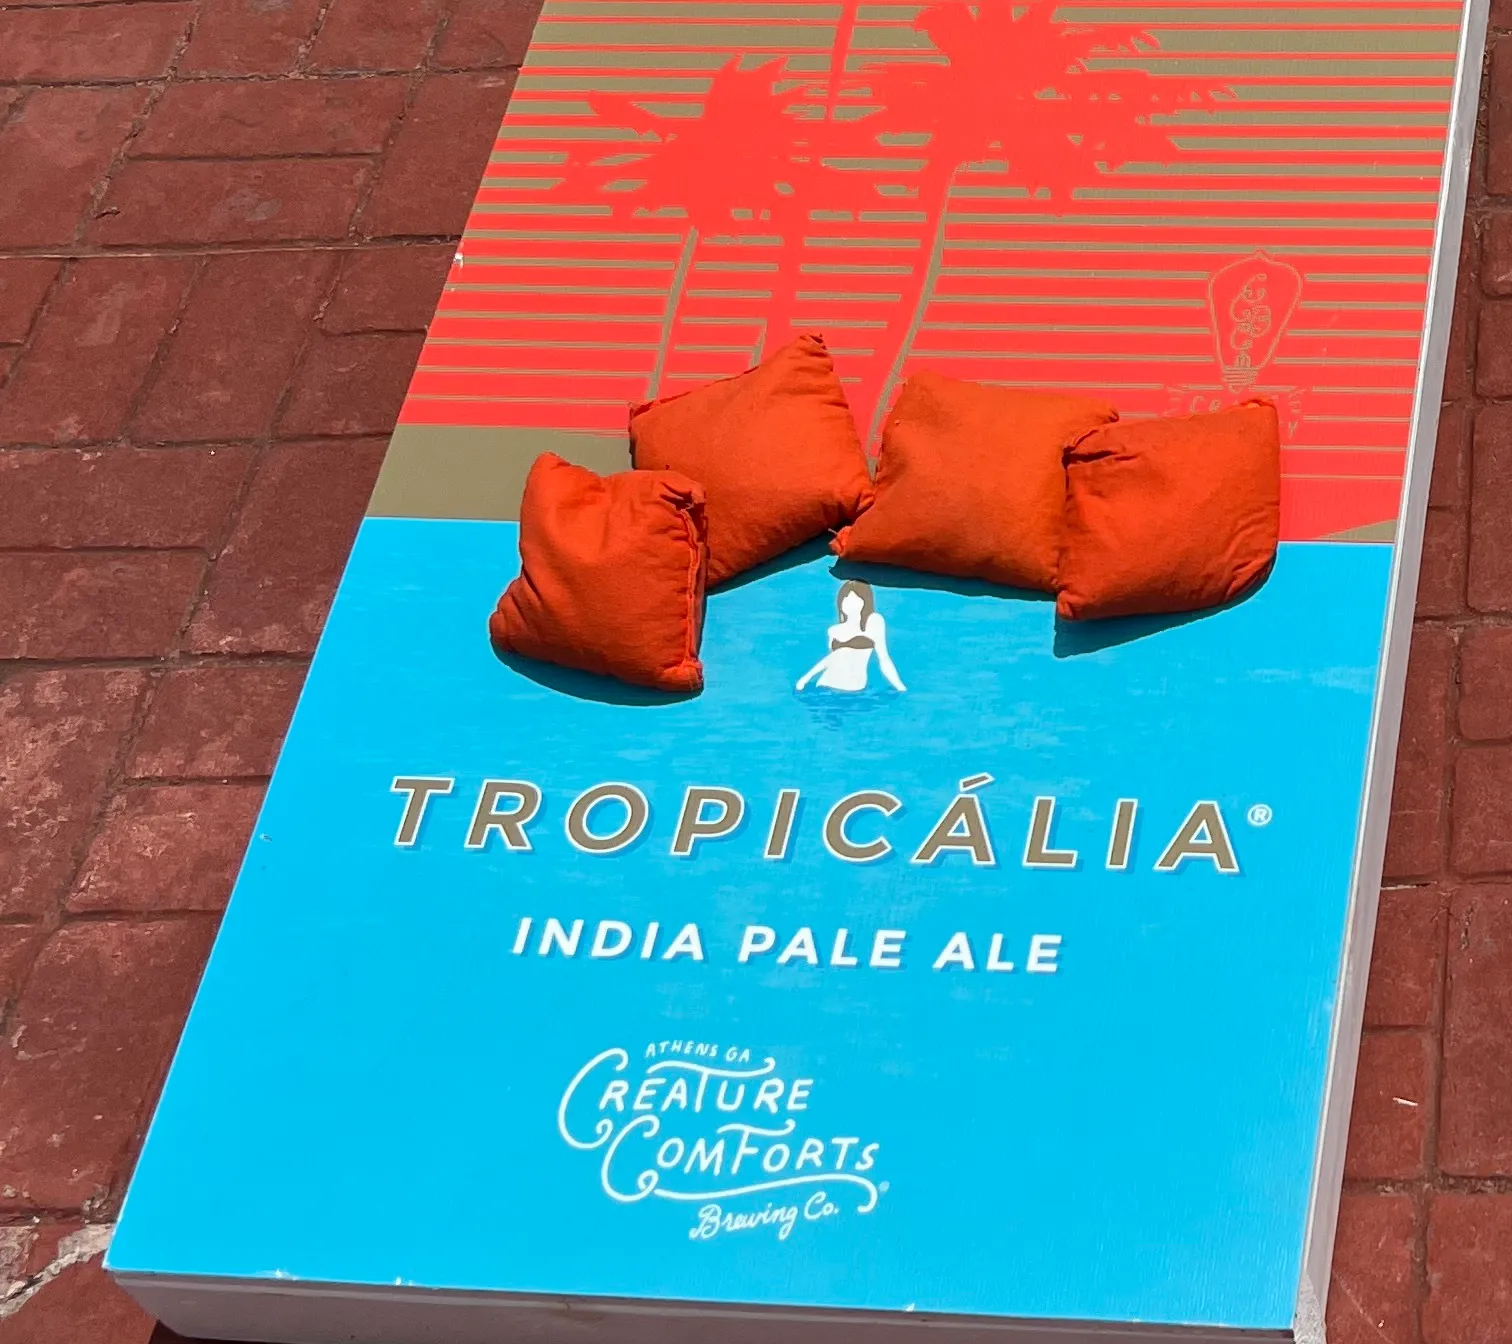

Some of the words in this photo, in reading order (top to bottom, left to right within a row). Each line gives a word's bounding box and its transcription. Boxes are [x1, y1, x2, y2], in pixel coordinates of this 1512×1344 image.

[511, 916, 705, 963] INDIA
[738, 924, 907, 969] PALE
[934, 933, 1063, 974] ALE
[645, 1039, 718, 1058] ATHENS
[725, 1045, 751, 1063] GA
[557, 1047, 814, 1149] CREATURE
[688, 1202, 799, 1241] Brewing
